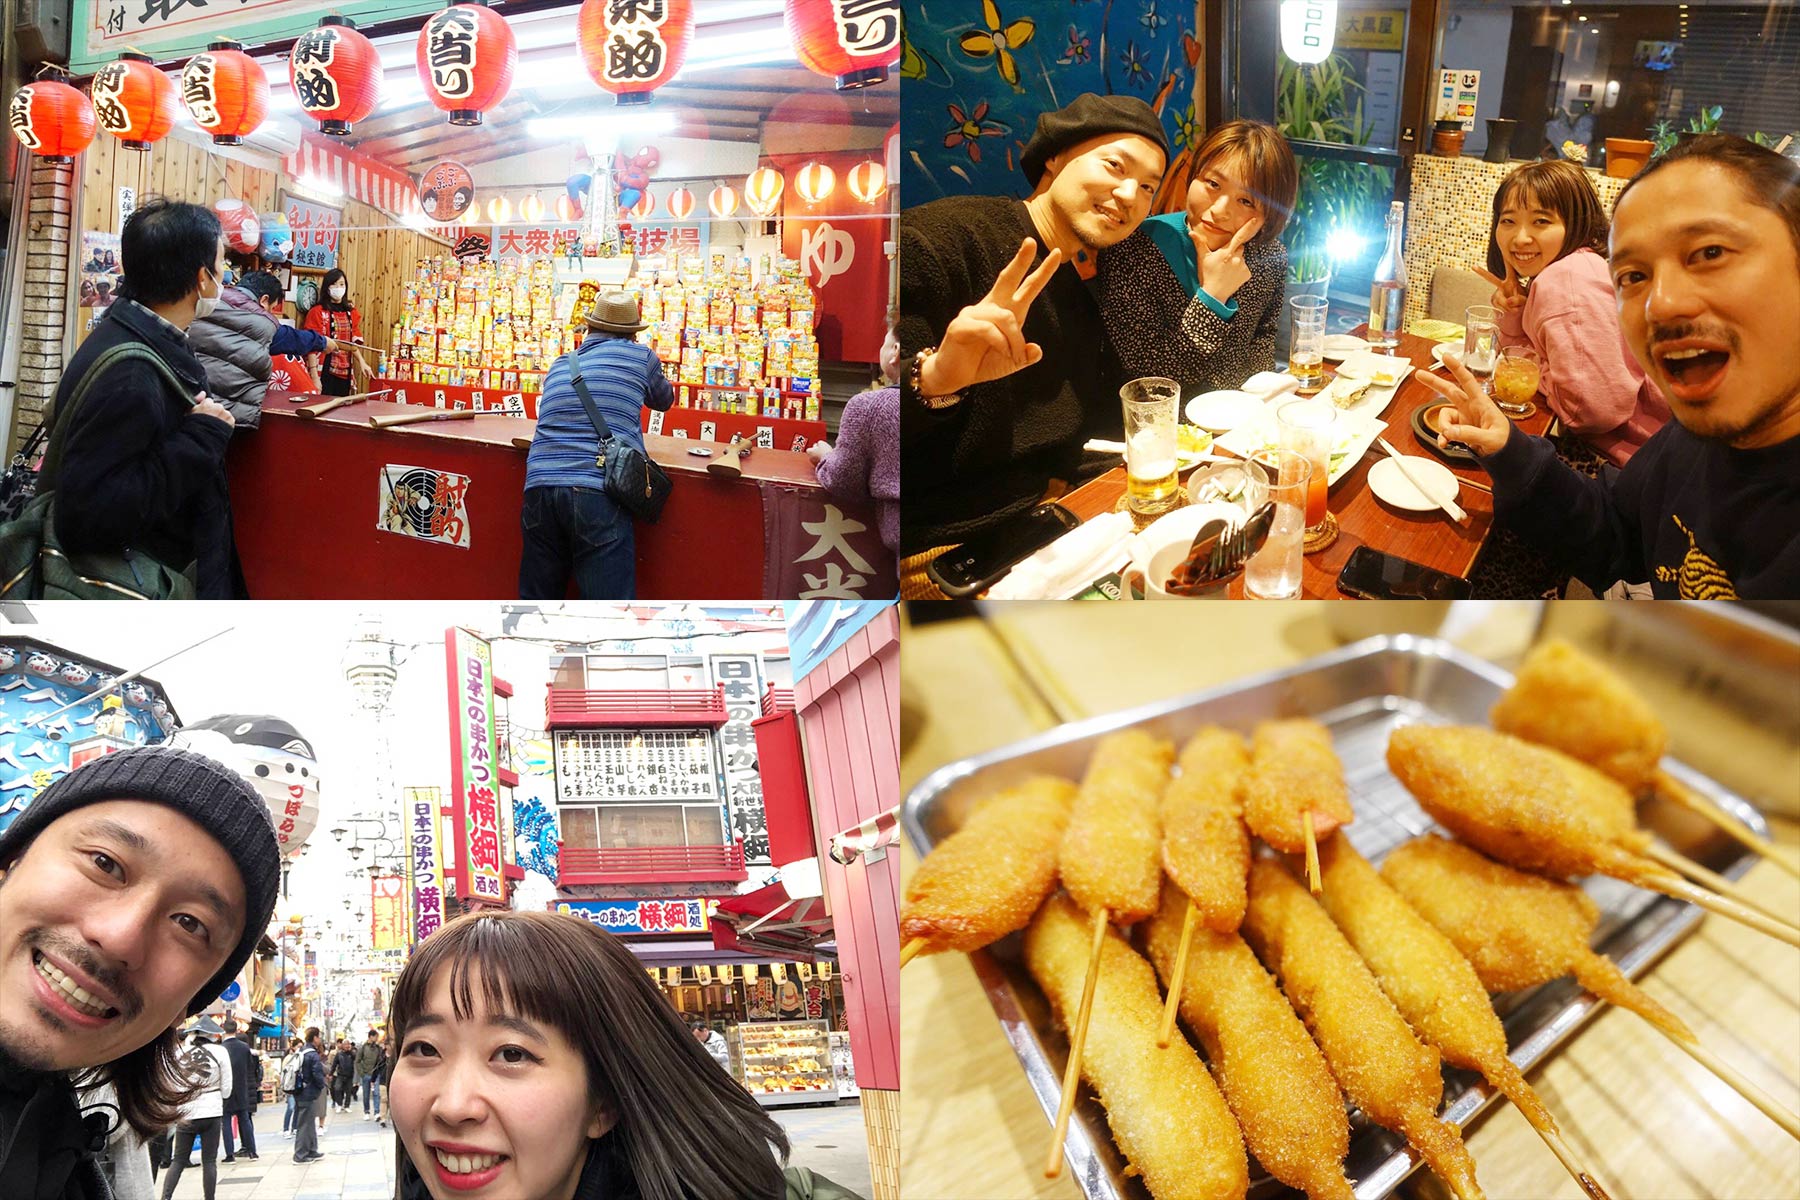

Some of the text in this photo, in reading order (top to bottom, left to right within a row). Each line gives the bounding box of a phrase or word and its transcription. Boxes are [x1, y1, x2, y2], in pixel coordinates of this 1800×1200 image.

[430, 8, 475, 95] 大当り
[184, 55, 216, 123] 大当り
[289, 204, 339, 251] 射的
[799, 222, 855, 288] ゆ
[431, 473, 466, 544] 射的
[467, 656, 490, 784] 日本一の串かつ
[414, 803, 435, 883] 日本一の串かつ
[467, 783, 499, 873] 横綱
[474, 875, 499, 895] 酒処
[638, 902, 688, 930] 横綱
[687, 902, 702, 928] 酒処
